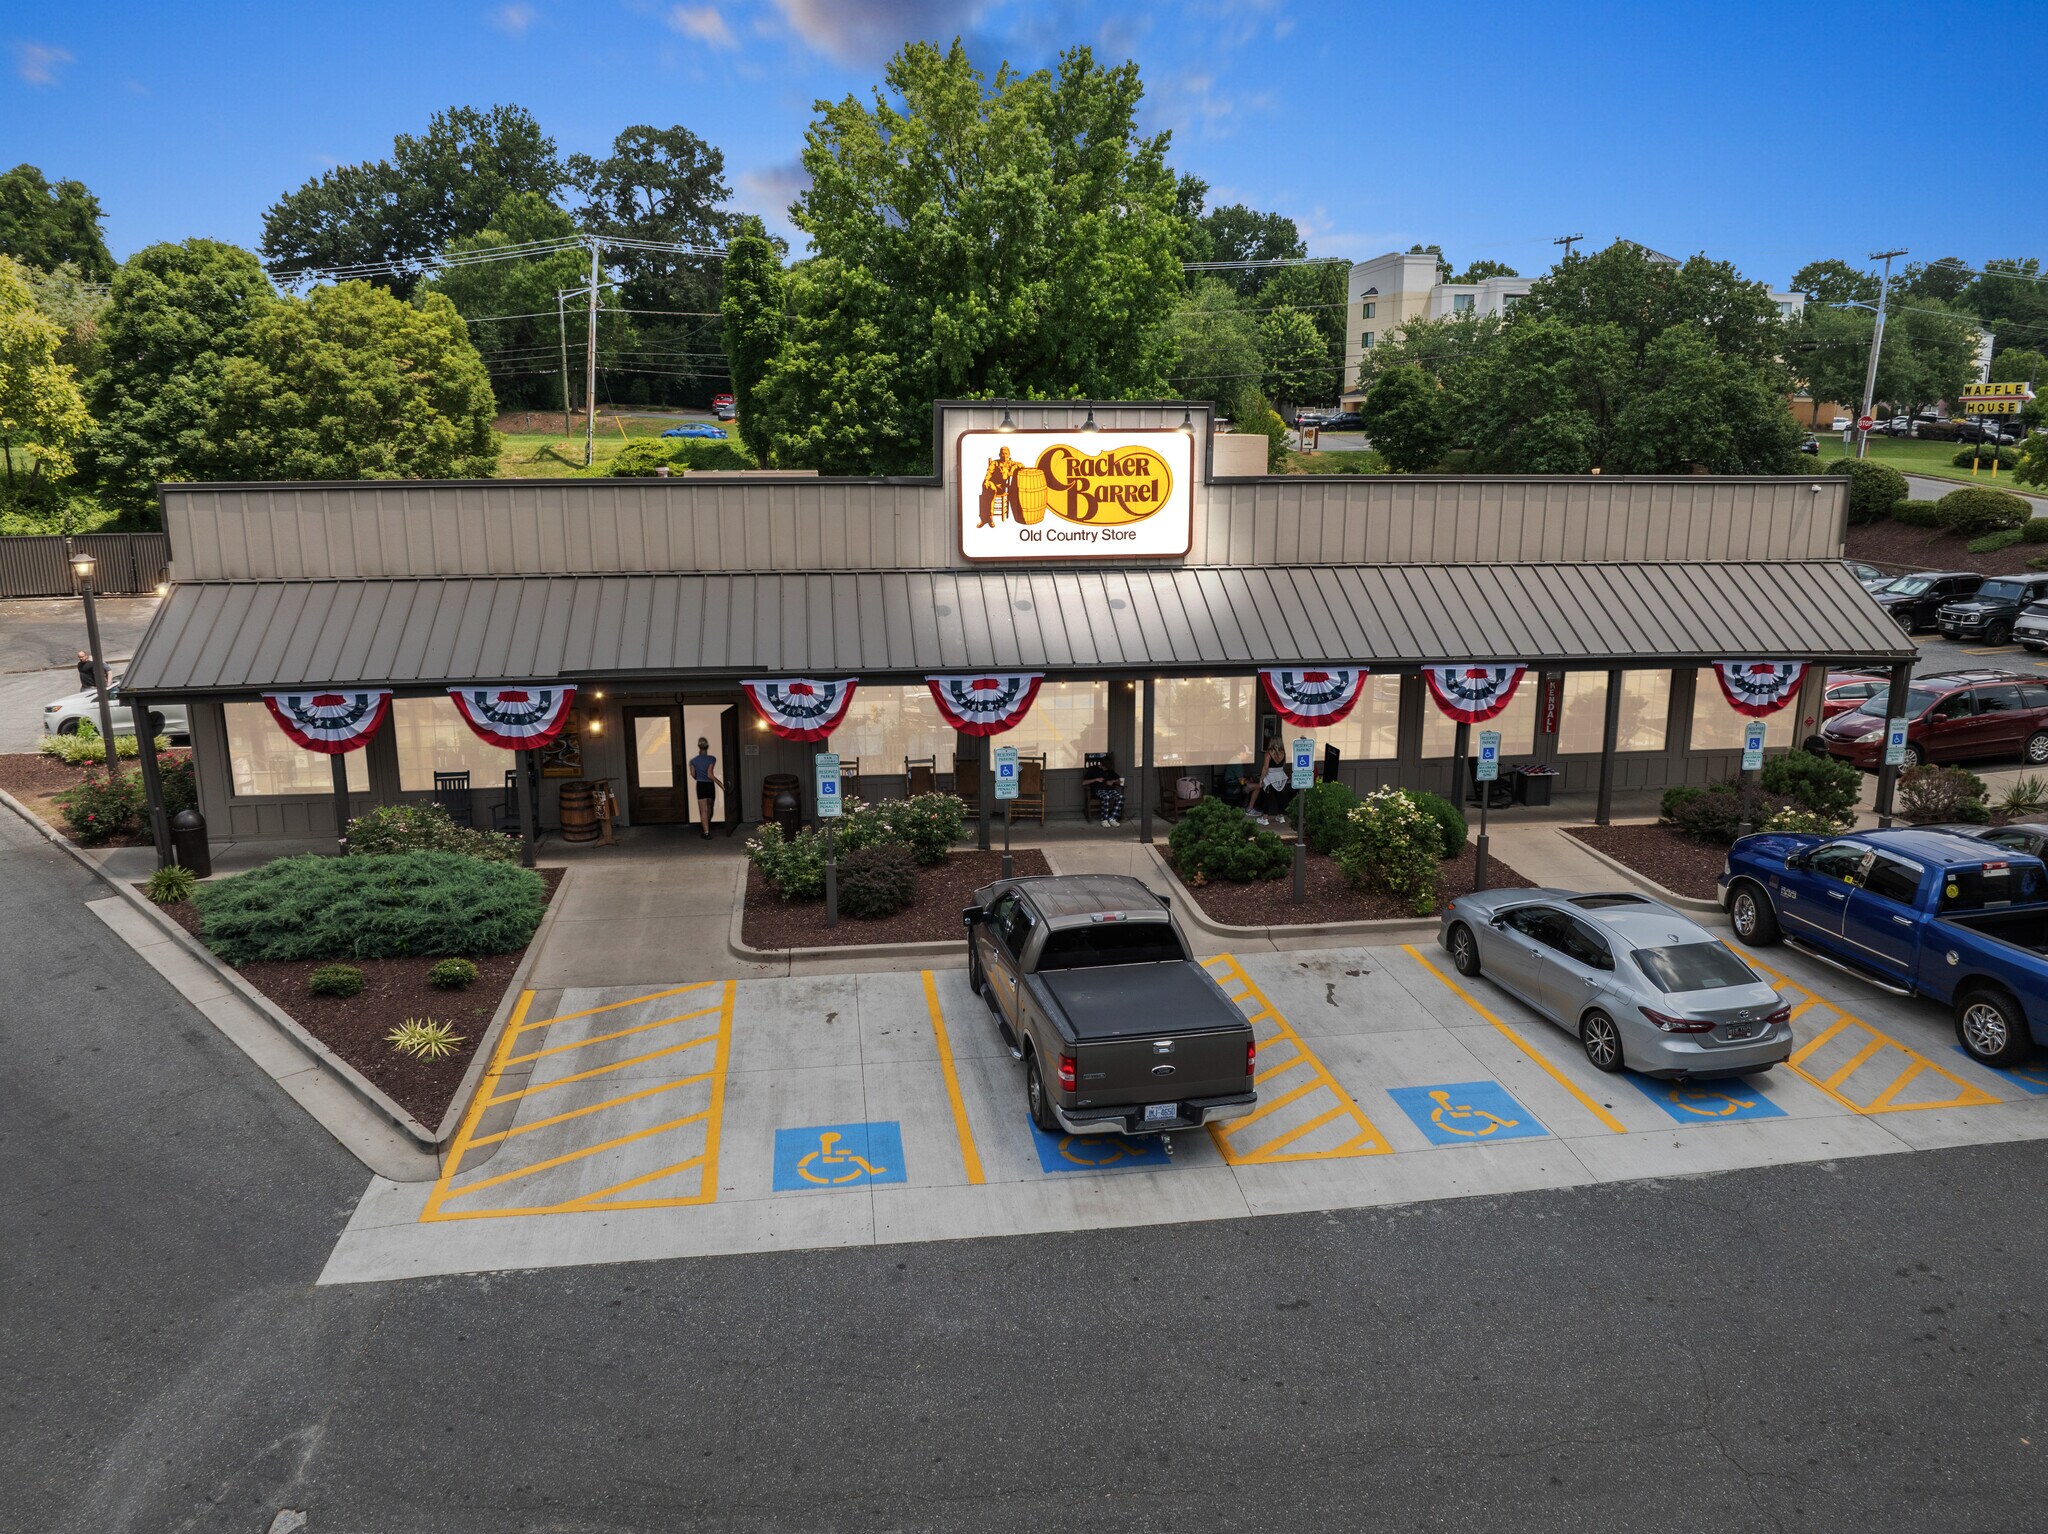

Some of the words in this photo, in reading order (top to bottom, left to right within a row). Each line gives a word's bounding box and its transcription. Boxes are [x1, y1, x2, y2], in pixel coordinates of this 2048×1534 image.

[1964, 384, 2023, 395] WAFFLE
[1967, 402, 2016, 413] HOUSE
[1037, 447, 1150, 491] Cracker
[1066, 477, 1159, 522] Barrel
[1019, 529, 1042, 542] Old
[1046, 529, 1098, 543] Country
[1101, 529, 1137, 541] Store
[1545, 681, 1556, 733] KENDALL
